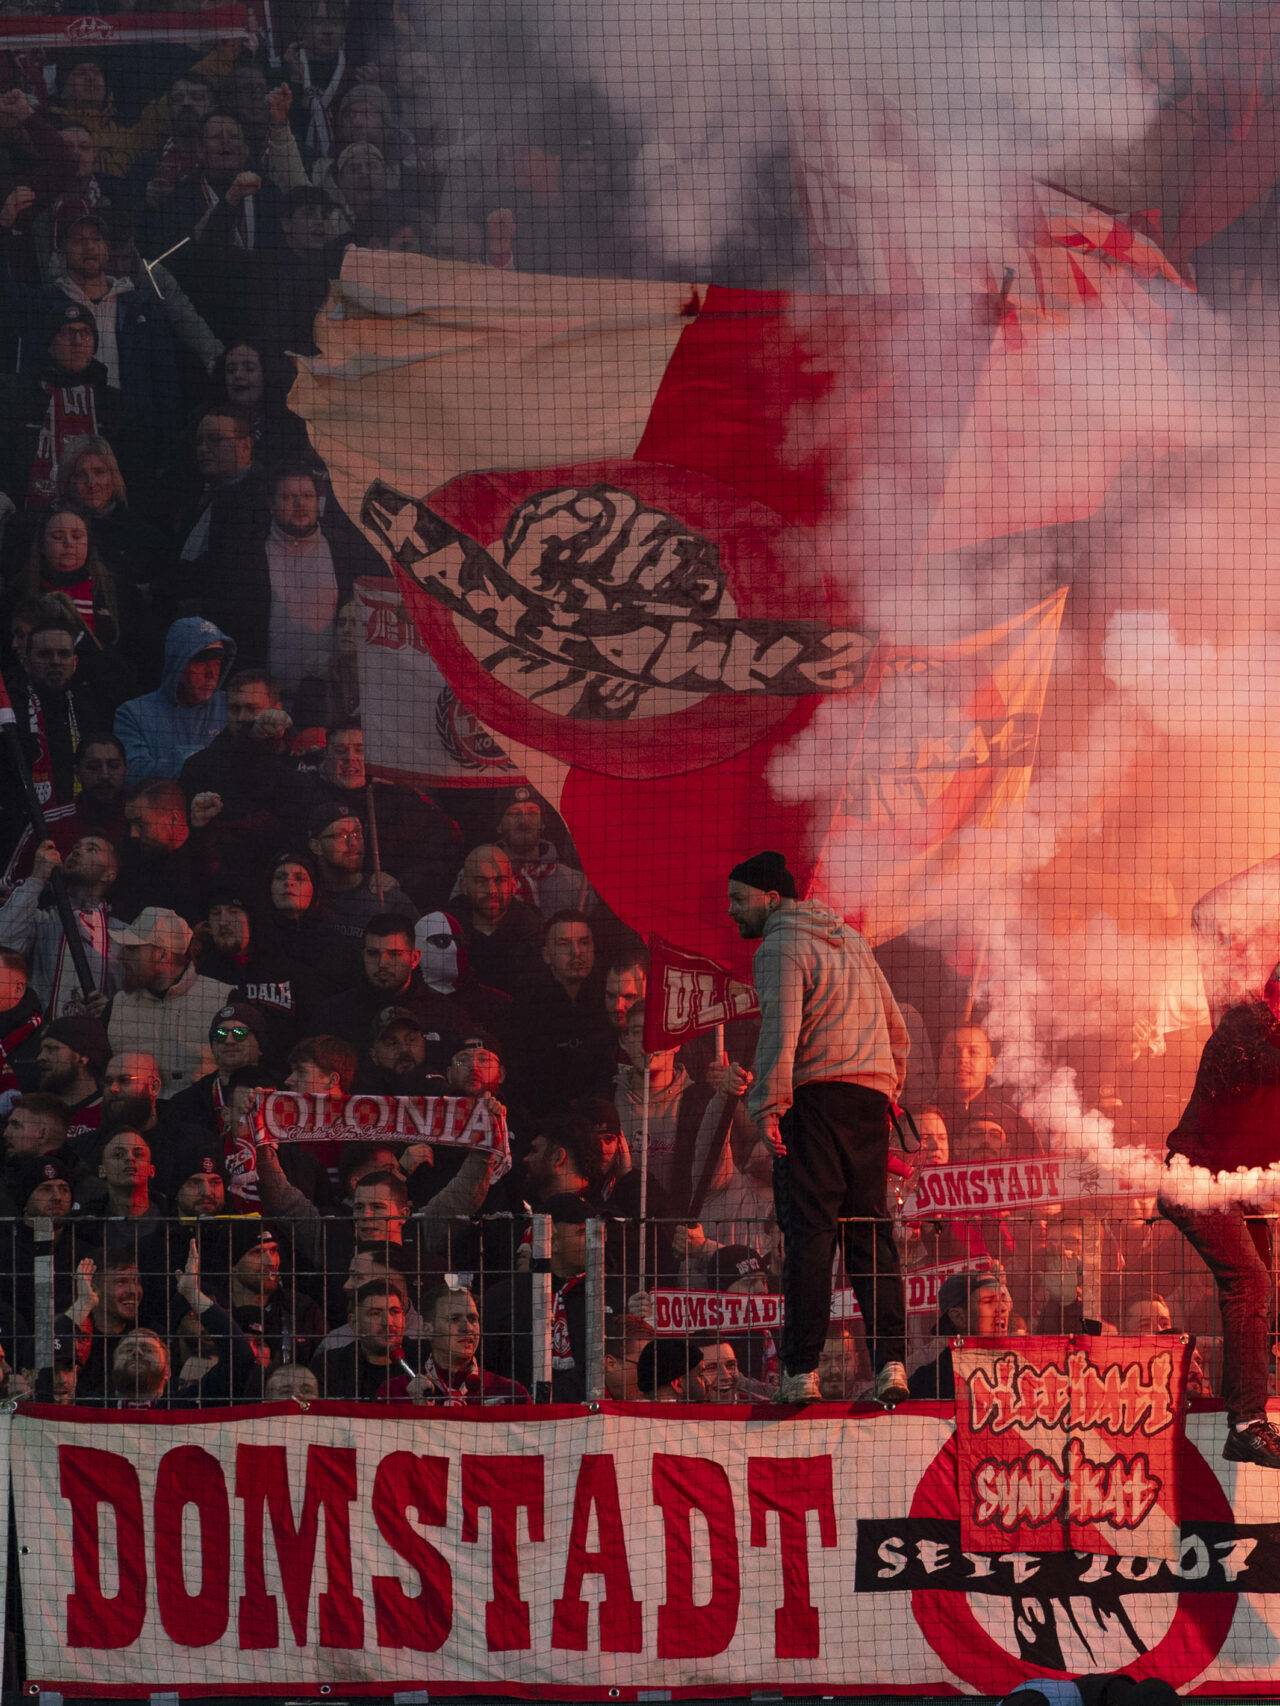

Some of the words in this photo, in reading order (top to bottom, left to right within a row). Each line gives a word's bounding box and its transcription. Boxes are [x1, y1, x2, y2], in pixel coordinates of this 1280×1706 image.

[244, 980, 293, 1009] DALE
[260, 1090, 497, 1148] OLONIA
[915, 1163, 1061, 1210] DOMSTADT
[656, 1295, 785, 1328] DOMSTAD
[972, 1437, 1162, 1533] SYNDIKAT
[58, 1442, 839, 1660] DOMSTADT
